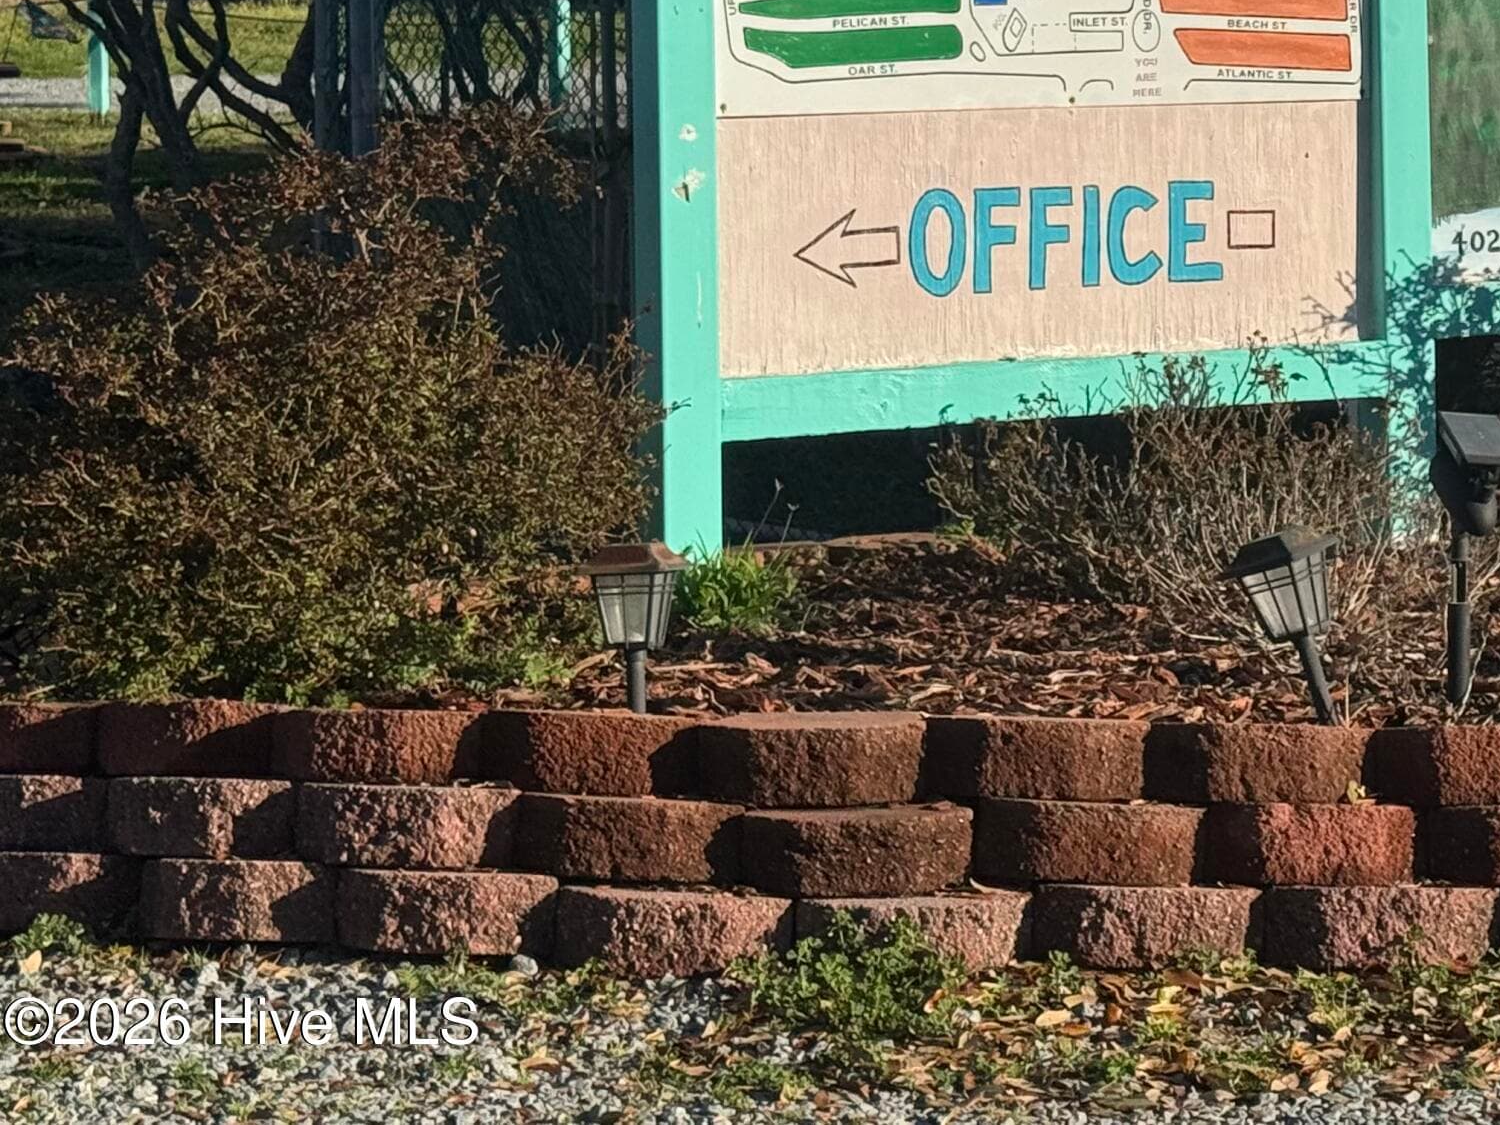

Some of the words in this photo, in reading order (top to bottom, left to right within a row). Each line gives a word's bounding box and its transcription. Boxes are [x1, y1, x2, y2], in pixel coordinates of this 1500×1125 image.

[832, 17, 886, 28] PELICAN
[1072, 18, 1107, 27] INLET
[1227, 19, 1268, 30] BEACH
[1134, 58, 1158, 67] YOU
[848, 65, 875, 76] OAR
[1217, 69, 1274, 80] ATLANTIC
[1135, 73, 1158, 81] ARE
[908, 180, 1223, 297] OFFICE
